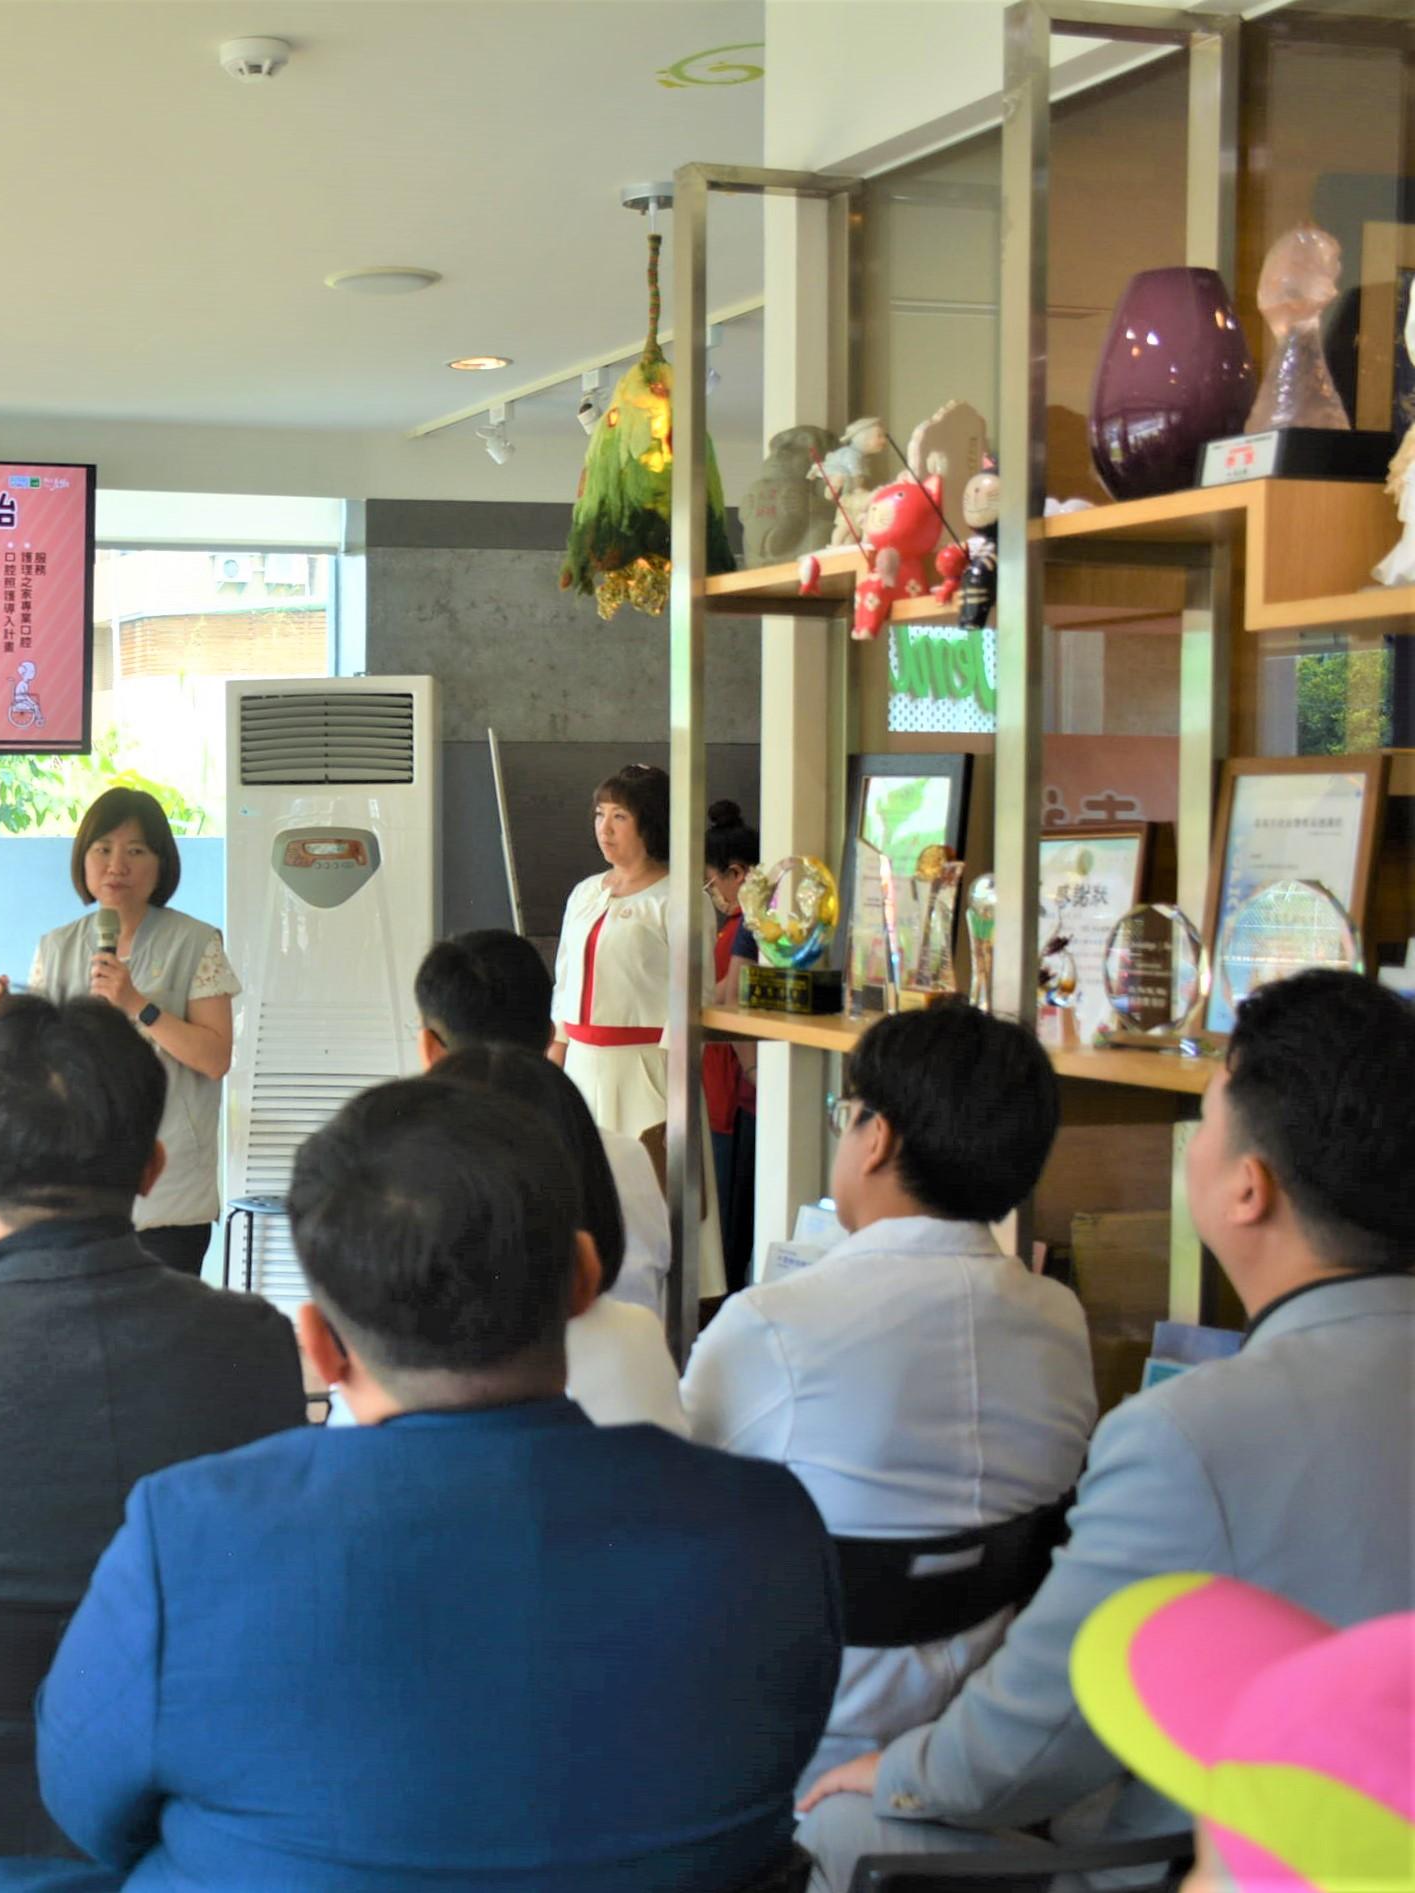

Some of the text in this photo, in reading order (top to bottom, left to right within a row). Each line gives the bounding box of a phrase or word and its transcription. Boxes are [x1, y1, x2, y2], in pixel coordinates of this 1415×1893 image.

[4, 552, 16, 652] 口腔照護導入計畫
